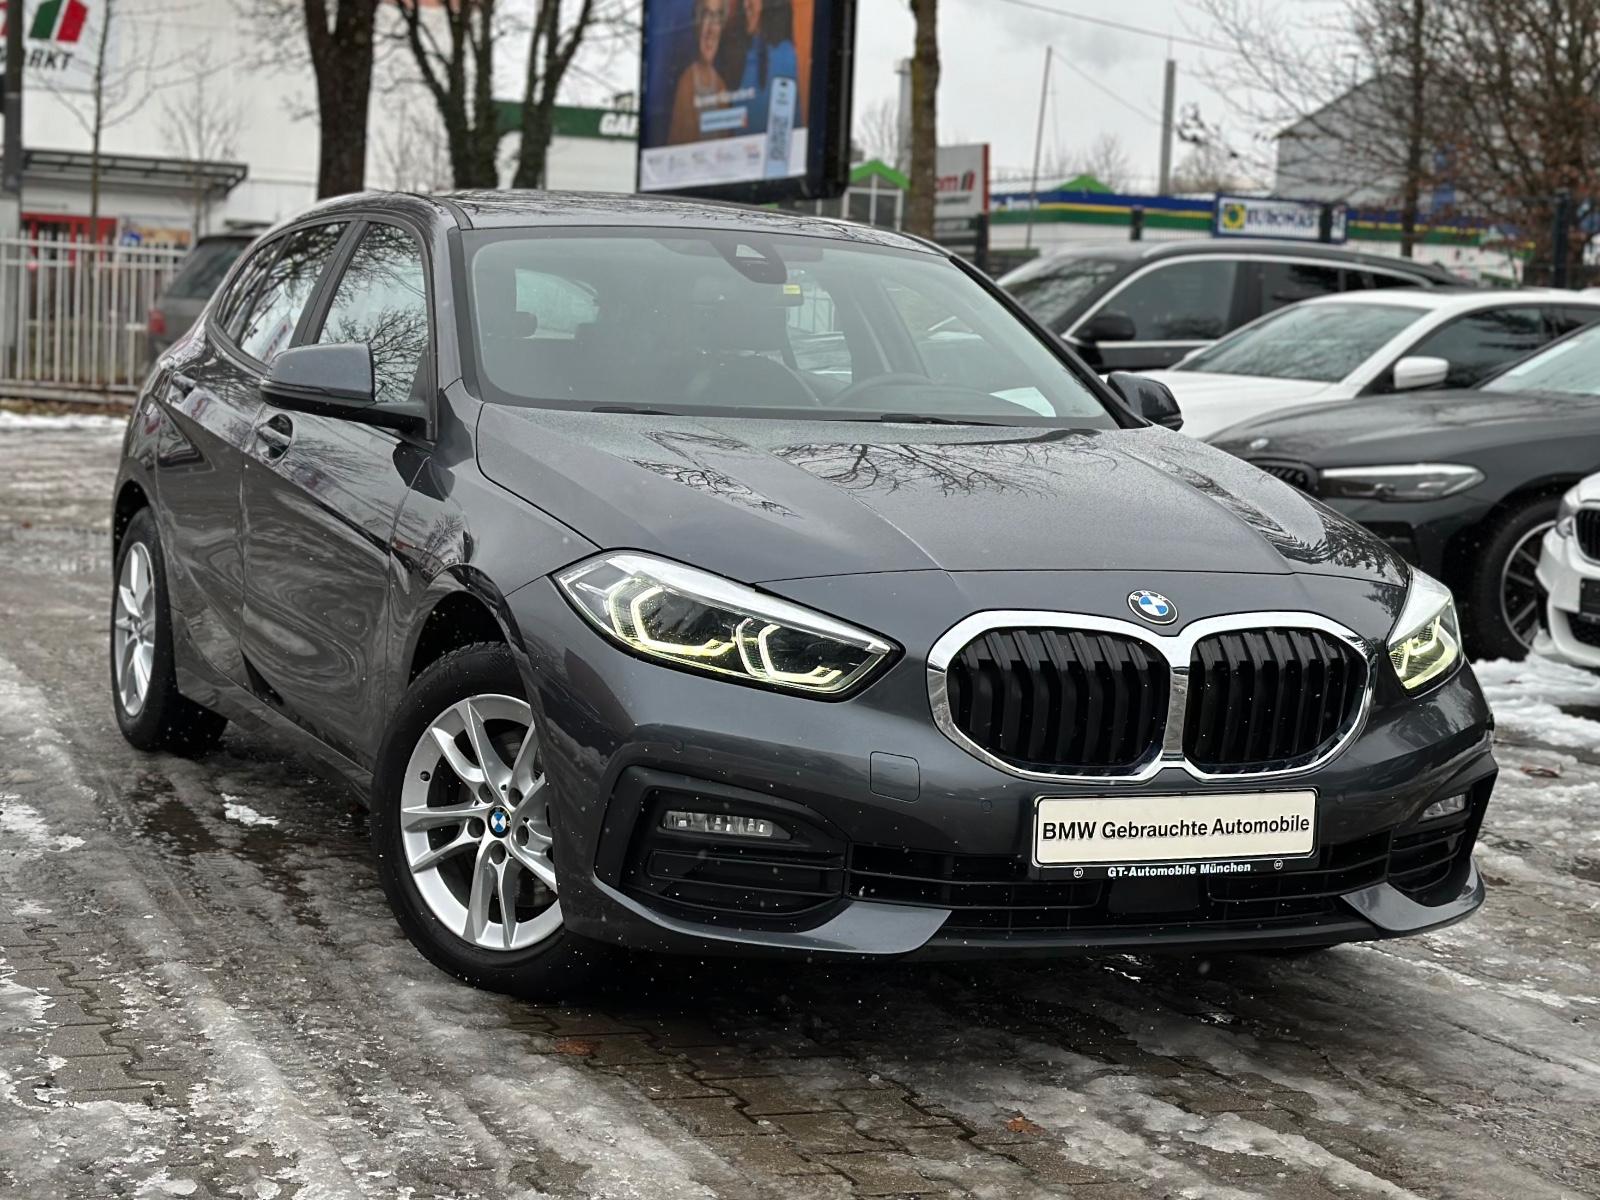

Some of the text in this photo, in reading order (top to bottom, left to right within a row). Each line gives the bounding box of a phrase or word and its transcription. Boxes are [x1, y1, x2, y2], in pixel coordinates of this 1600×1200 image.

[30, 48, 74, 71] RKT
[1042, 814, 1310, 840] BMW Gebrauchte Automobile
[1107, 862, 1251, 877] GT-Automobile München
